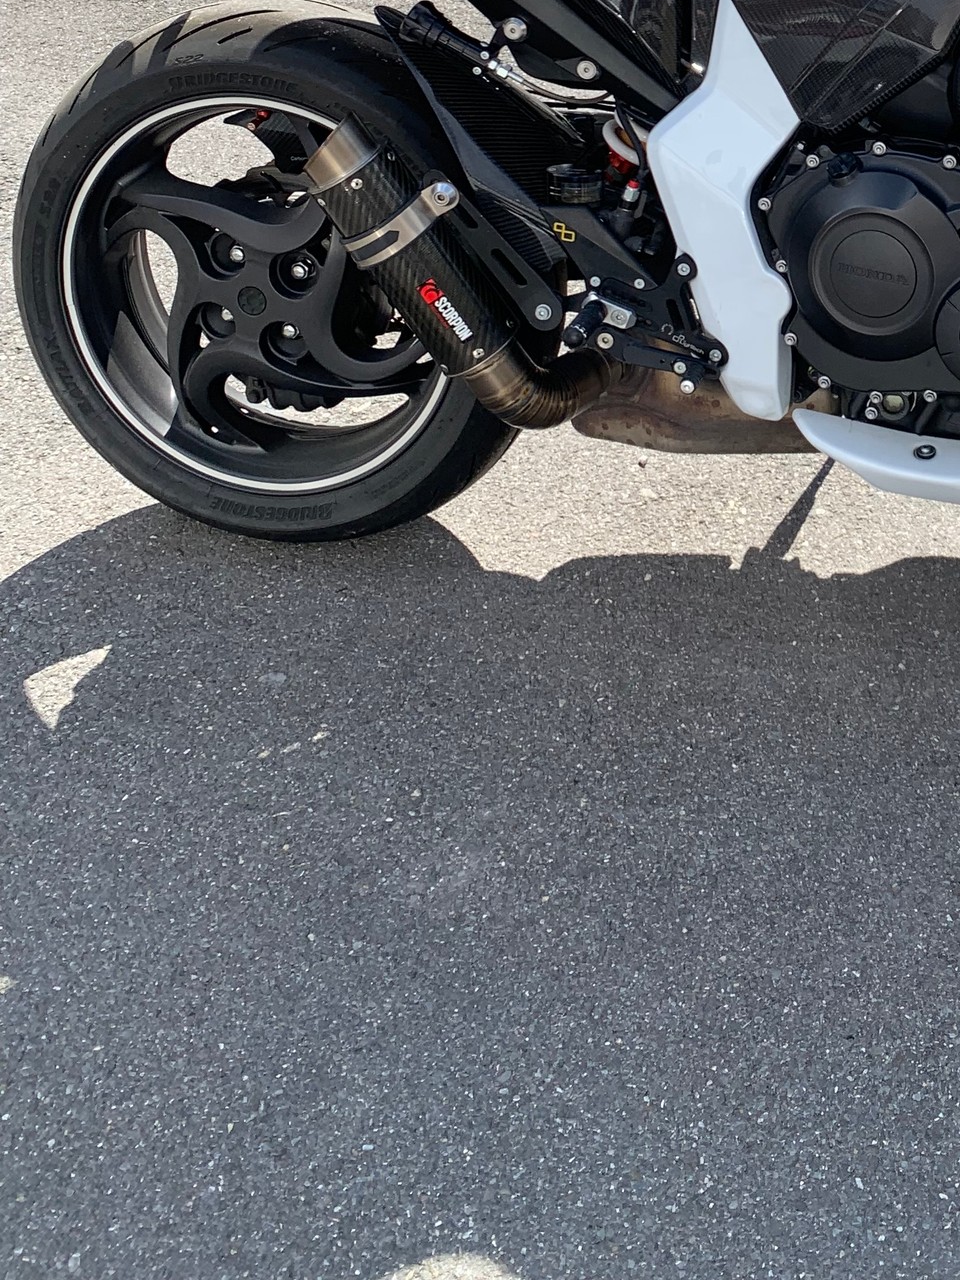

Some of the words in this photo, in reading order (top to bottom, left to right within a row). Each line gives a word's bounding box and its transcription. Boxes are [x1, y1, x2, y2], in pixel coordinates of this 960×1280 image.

[167, 71, 300, 94] BRIDGESTONE
[837, 262, 910, 286] HONDA
[433, 295, 474, 343] SCORPION
[208, 495, 334, 523] BRIDGESTONE
